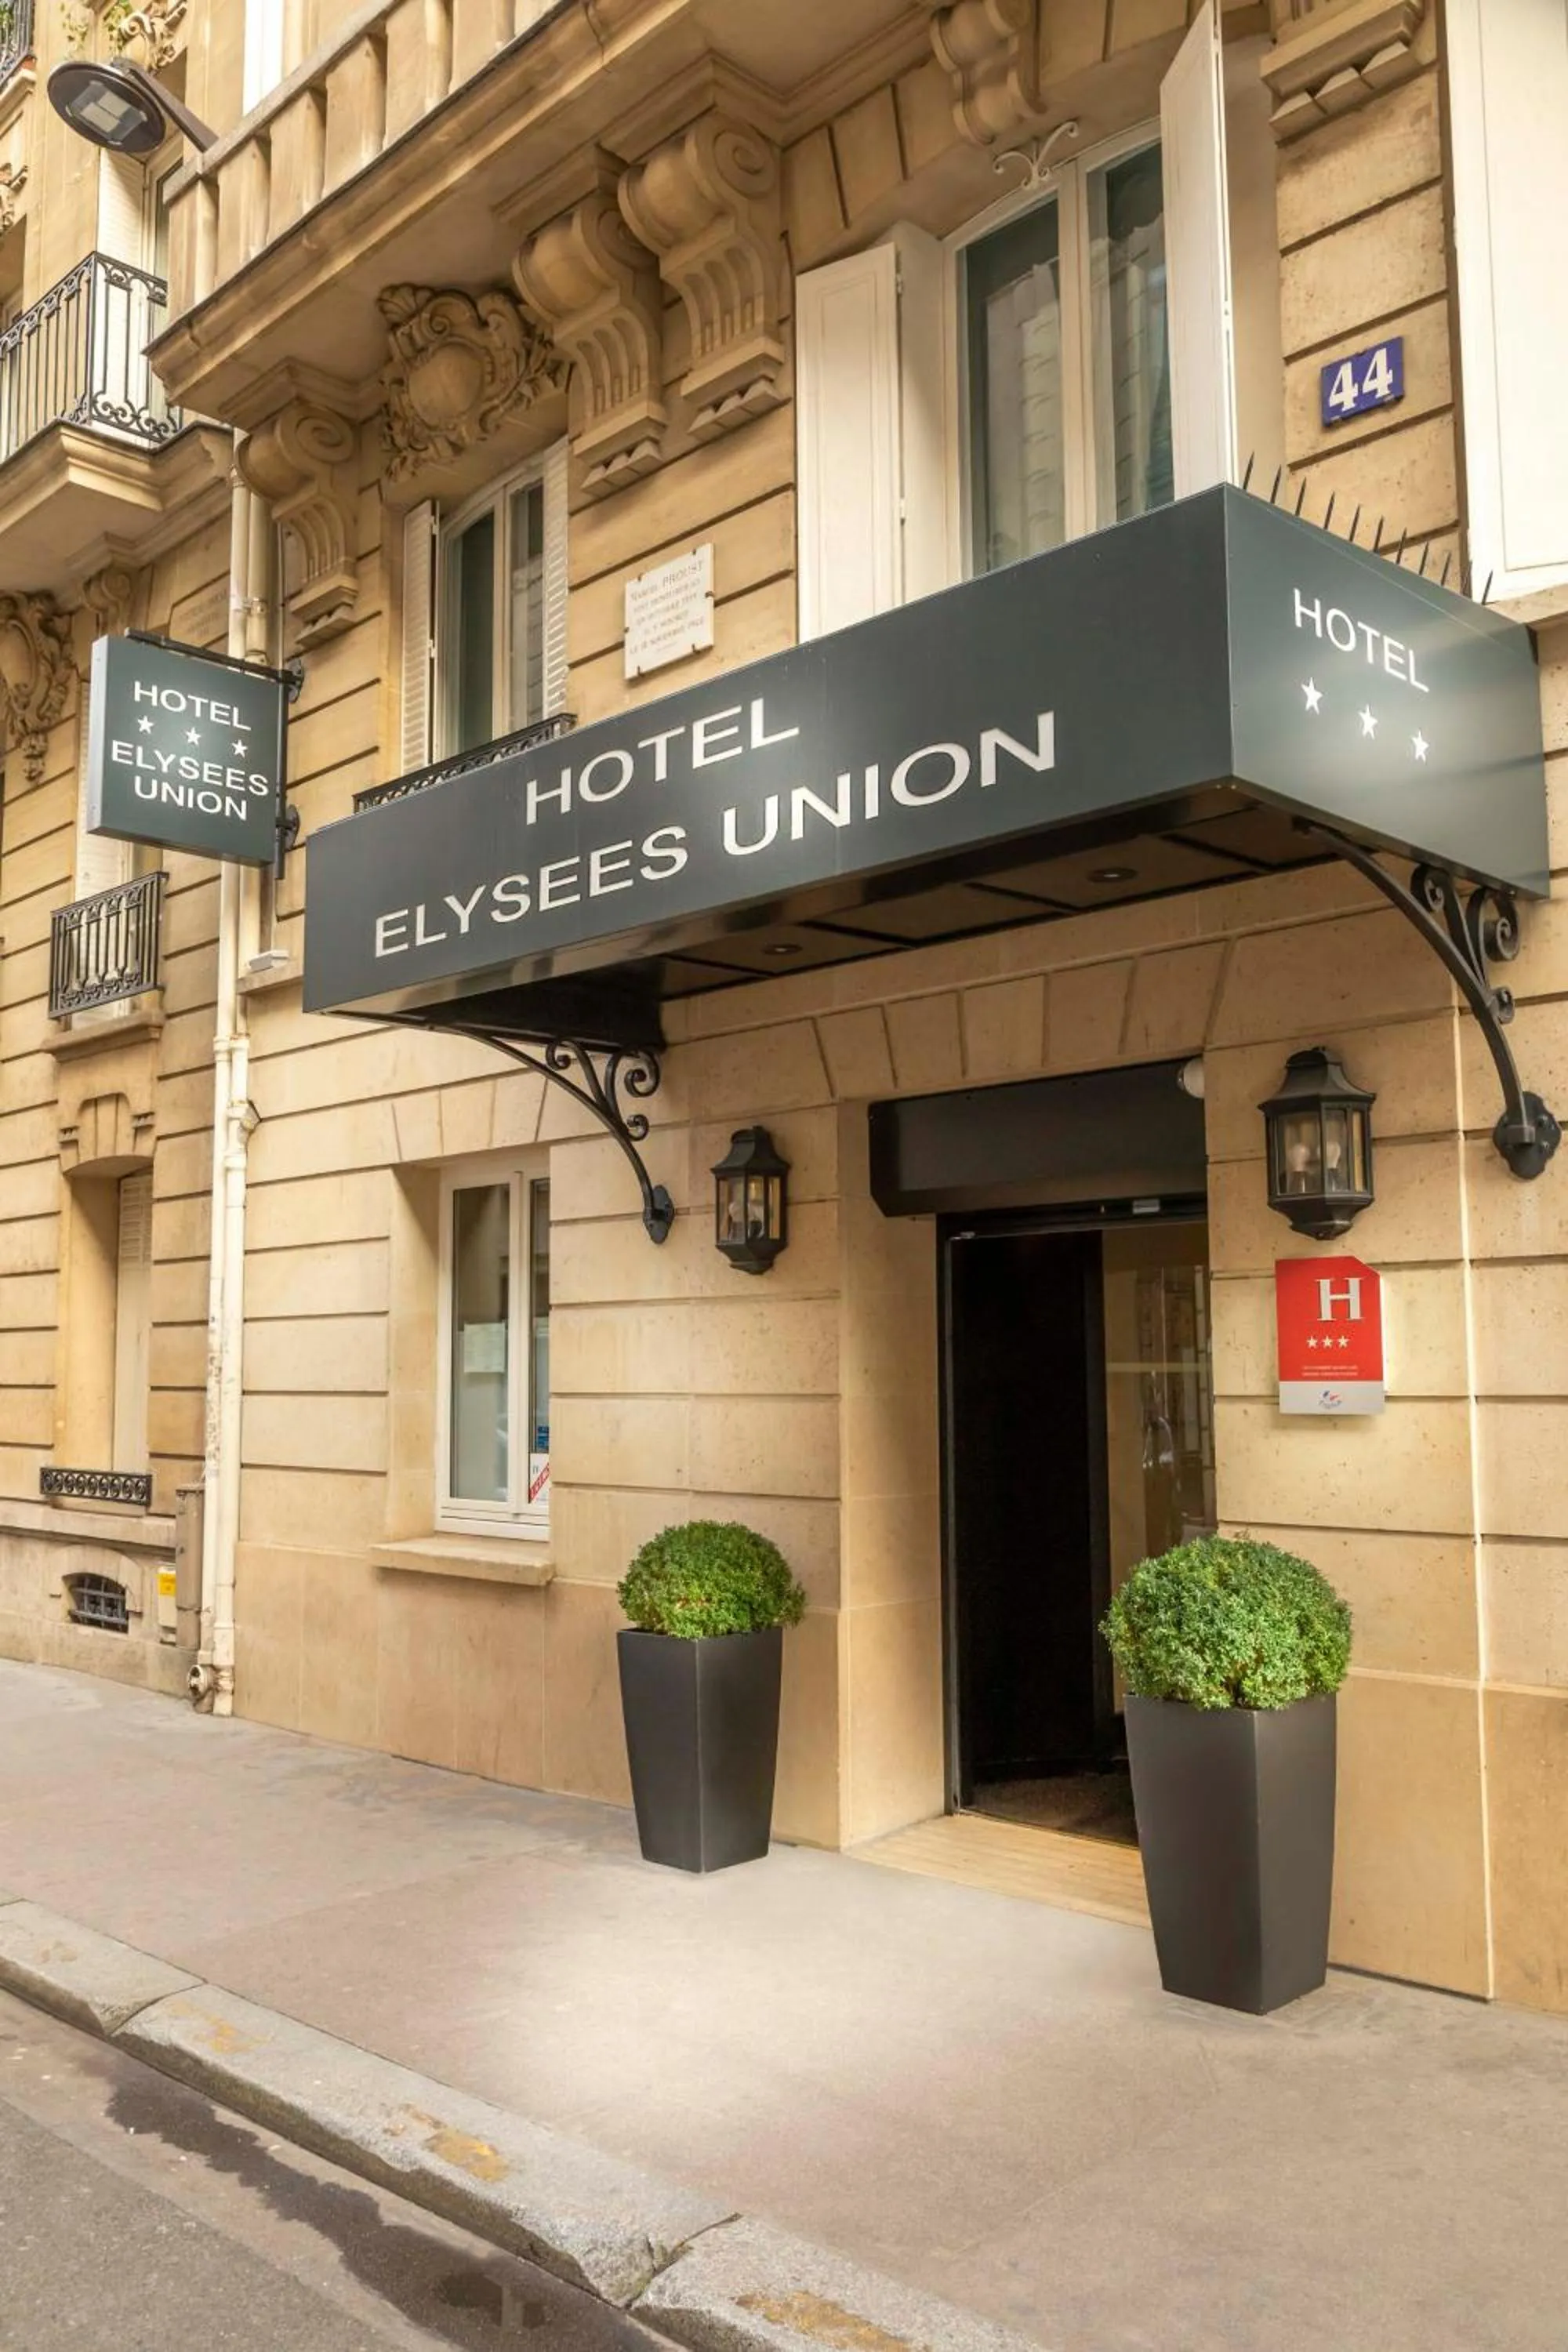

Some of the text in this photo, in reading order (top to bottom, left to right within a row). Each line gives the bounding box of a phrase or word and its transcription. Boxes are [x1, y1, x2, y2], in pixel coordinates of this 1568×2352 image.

[1329, 347, 1393, 412] 44
[1294, 588, 1429, 693] HOTEL
[134, 681, 252, 731] HOTEL
[111, 739, 269, 797] ELYSEES
[527, 698, 800, 825] HOTEL
[134, 775, 247, 821] UNION
[375, 711, 1055, 957] ELYSEES UNION
[1314, 1276, 1365, 1322] H
